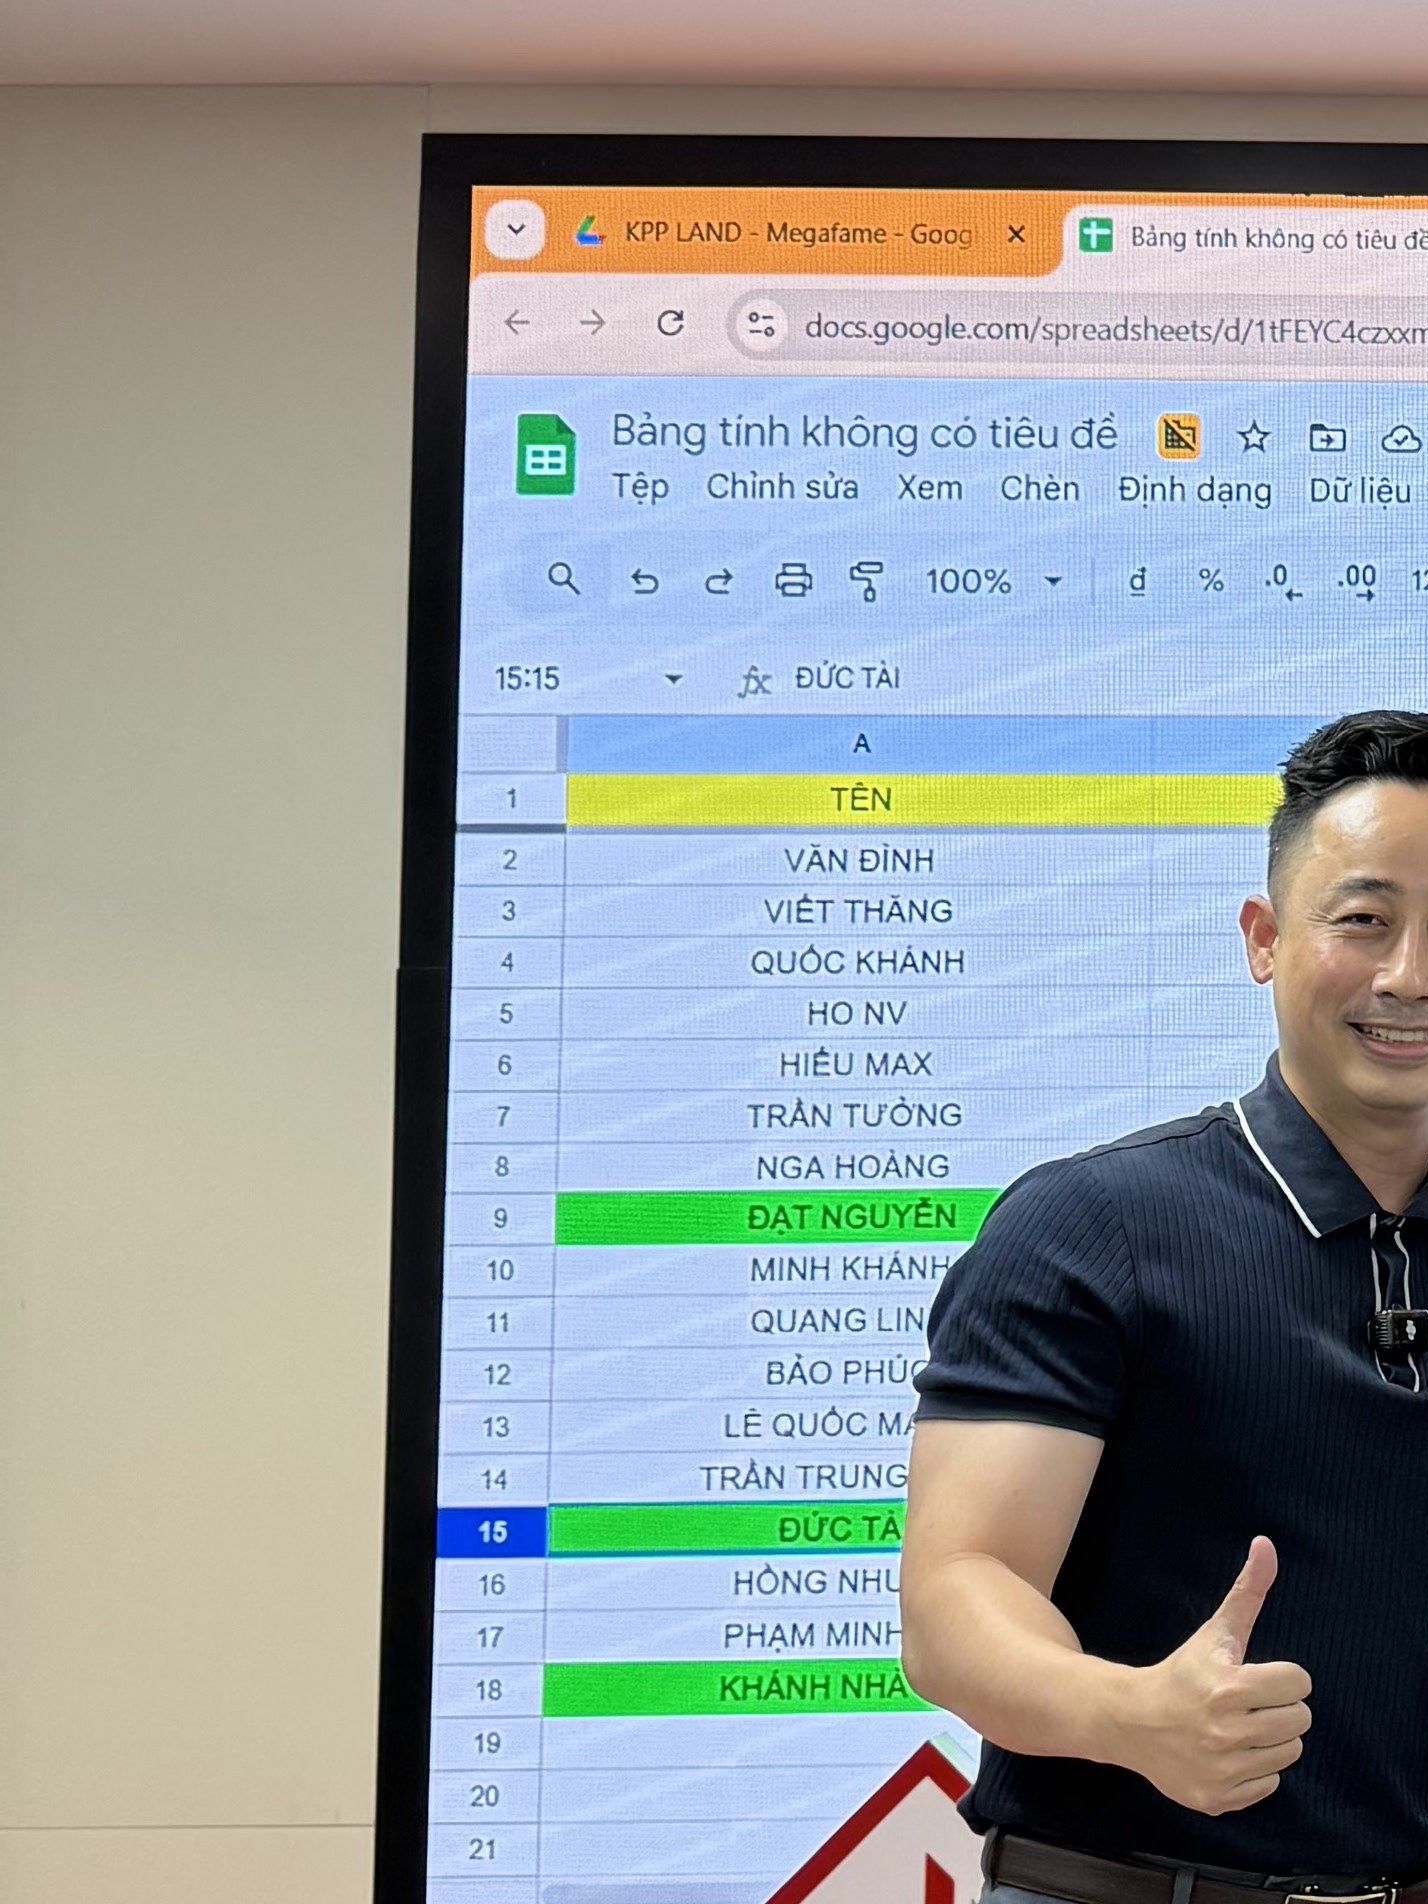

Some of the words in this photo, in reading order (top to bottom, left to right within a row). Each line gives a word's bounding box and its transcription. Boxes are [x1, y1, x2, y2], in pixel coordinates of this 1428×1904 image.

[625, 221, 669, 244] KPP
[676, 221, 742, 244] LAND
[766, 222, 886, 249] Megafame
[911, 223, 972, 250] Goog
[1132, 225, 1187, 251] Bảng
[1195, 227, 1238, 250] tính
[1246, 227, 1312, 253] không
[1323, 228, 1347, 250] có
[1356, 229, 1397, 250] tiêu
[613, 412, 705, 454] Bảng
[720, 416, 789, 449] tính
[802, 414, 917, 457] không
[931, 417, 977, 451] có
[989, 416, 1060, 451] tiêu
[1072, 411, 1117, 450] đề
[613, 474, 669, 504] Tệp
[707, 472, 795, 500] Chỉnh
[806, 475, 859, 500] sửa
[898, 476, 962, 500] Xem
[1001, 473, 1080, 501] Chèn
[1119, 477, 1184, 508] Định
[1198, 478, 1272, 509] dạng
[1311, 477, 1352, 503] Dữ
[1361, 478, 1411, 508] liệu
[927, 568, 1011, 596] 100%
[495, 667, 560, 692] 15:15
[796, 660, 854, 691] ĐỨC
[862, 661, 899, 690] TÀI
[831, 782, 891, 811] TÊN
[785, 844, 847, 872] VĂN
[859, 844, 933, 872] ĐÌNH
[764, 894, 834, 923] VIẾT
[751, 945, 845, 975] QUỐC
[856, 946, 965, 974] KHÁNH
[808, 1002, 853, 1025] HO
[865, 1002, 907, 1025] NV
[866, 1052, 932, 1076] MAX
[748, 1099, 831, 1128] TRẦN
[757, 1156, 825, 1180] NGA
[837, 1150, 949, 1180] HOÀNG
[748, 1204, 813, 1236] ĐẠT
[822, 1198, 956, 1229] NGUYỄN
[488, 1260, 514, 1281] 10
[751, 1257, 830, 1281] MINH
[843, 1251, 949, 1280] KHÁNH
[488, 1312, 508, 1332] 11
[752, 1308, 866, 1334] QUANG
[485, 1364, 511, 1385] 12
[484, 1417, 509, 1437] 13
[725, 1408, 762, 1437] LÊ
[773, 1406, 866, 1439] QUỐC
[482, 1469, 507, 1489] 14
[700, 1459, 785, 1491] TRẦN
[796, 1464, 907, 1489] TRUNG
[479, 1521, 508, 1542] 15
[779, 1510, 851, 1542] ĐỨC
[480, 1575, 505, 1595] 16
[734, 1563, 827, 1595] HỒNG
[479, 1627, 502, 1647] 17
[724, 1622, 814, 1653] PHẠM
[477, 1681, 501, 1701] 18
[719, 1669, 830, 1701] KHÁNH
[475, 1733, 501, 1754] 19
[470, 1786, 499, 1807] 20
[469, 1839, 497, 1860] 21
